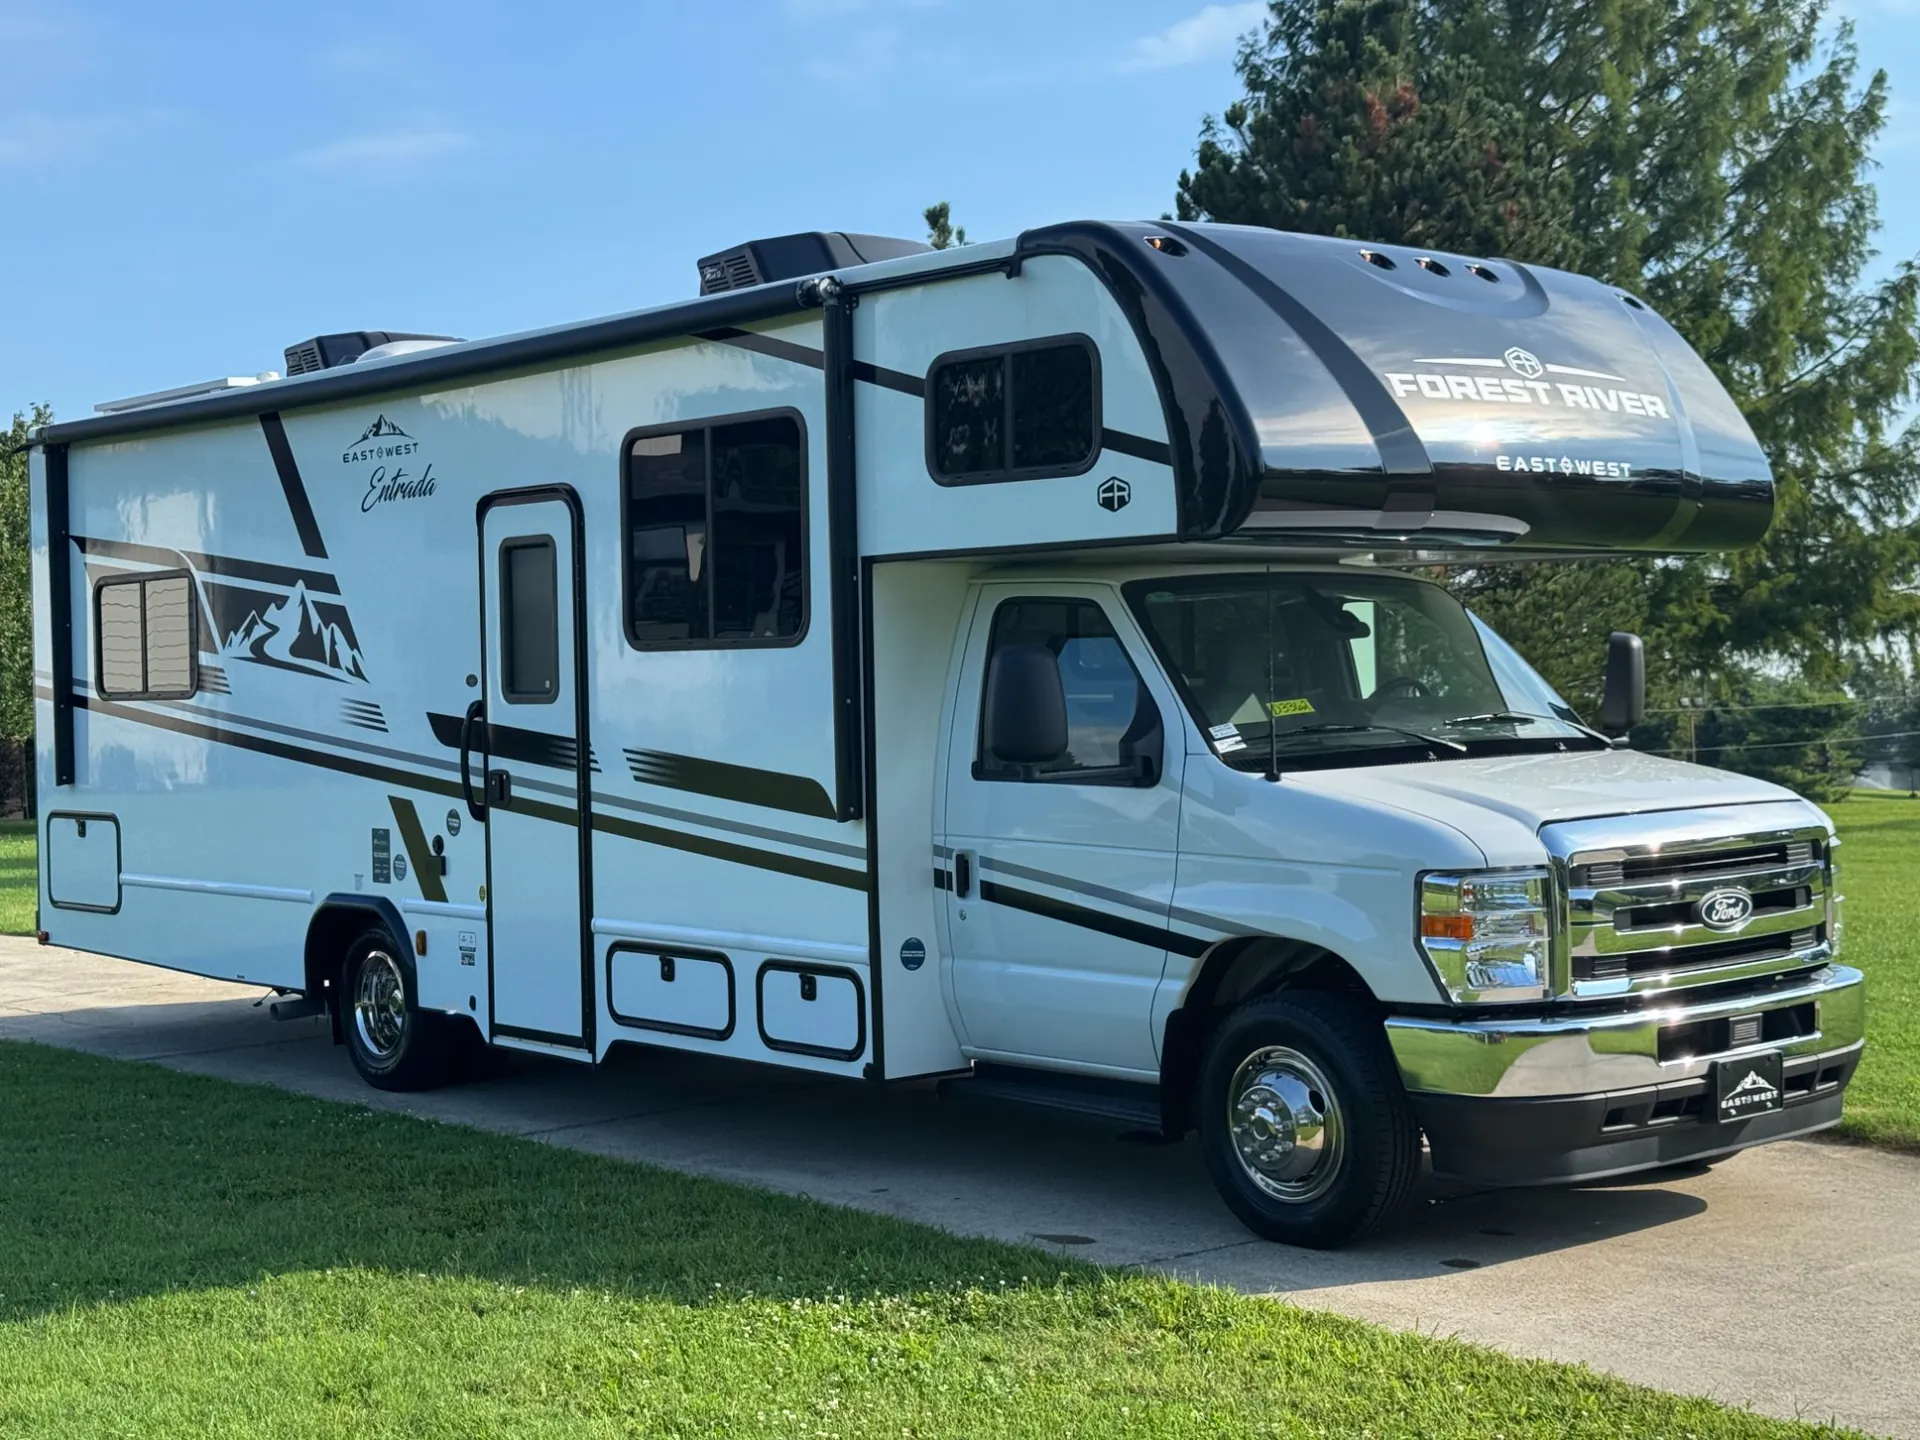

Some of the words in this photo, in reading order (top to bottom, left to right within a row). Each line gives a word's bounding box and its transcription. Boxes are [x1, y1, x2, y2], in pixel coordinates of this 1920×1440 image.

[1384, 372, 1551, 405] FOREST
[1555, 382, 1671, 419] RIVER
[342, 449, 375, 464] EAST
[385, 442, 419, 457] WEST
[1496, 455, 1553, 473] EAST
[1574, 458, 1632, 478] WEST
[361, 463, 438, 513] Entrada
[1711, 898, 1744, 921] Ford
[1720, 1096, 1747, 1109] EAST
[1752, 1090, 1779, 1102] WEST
